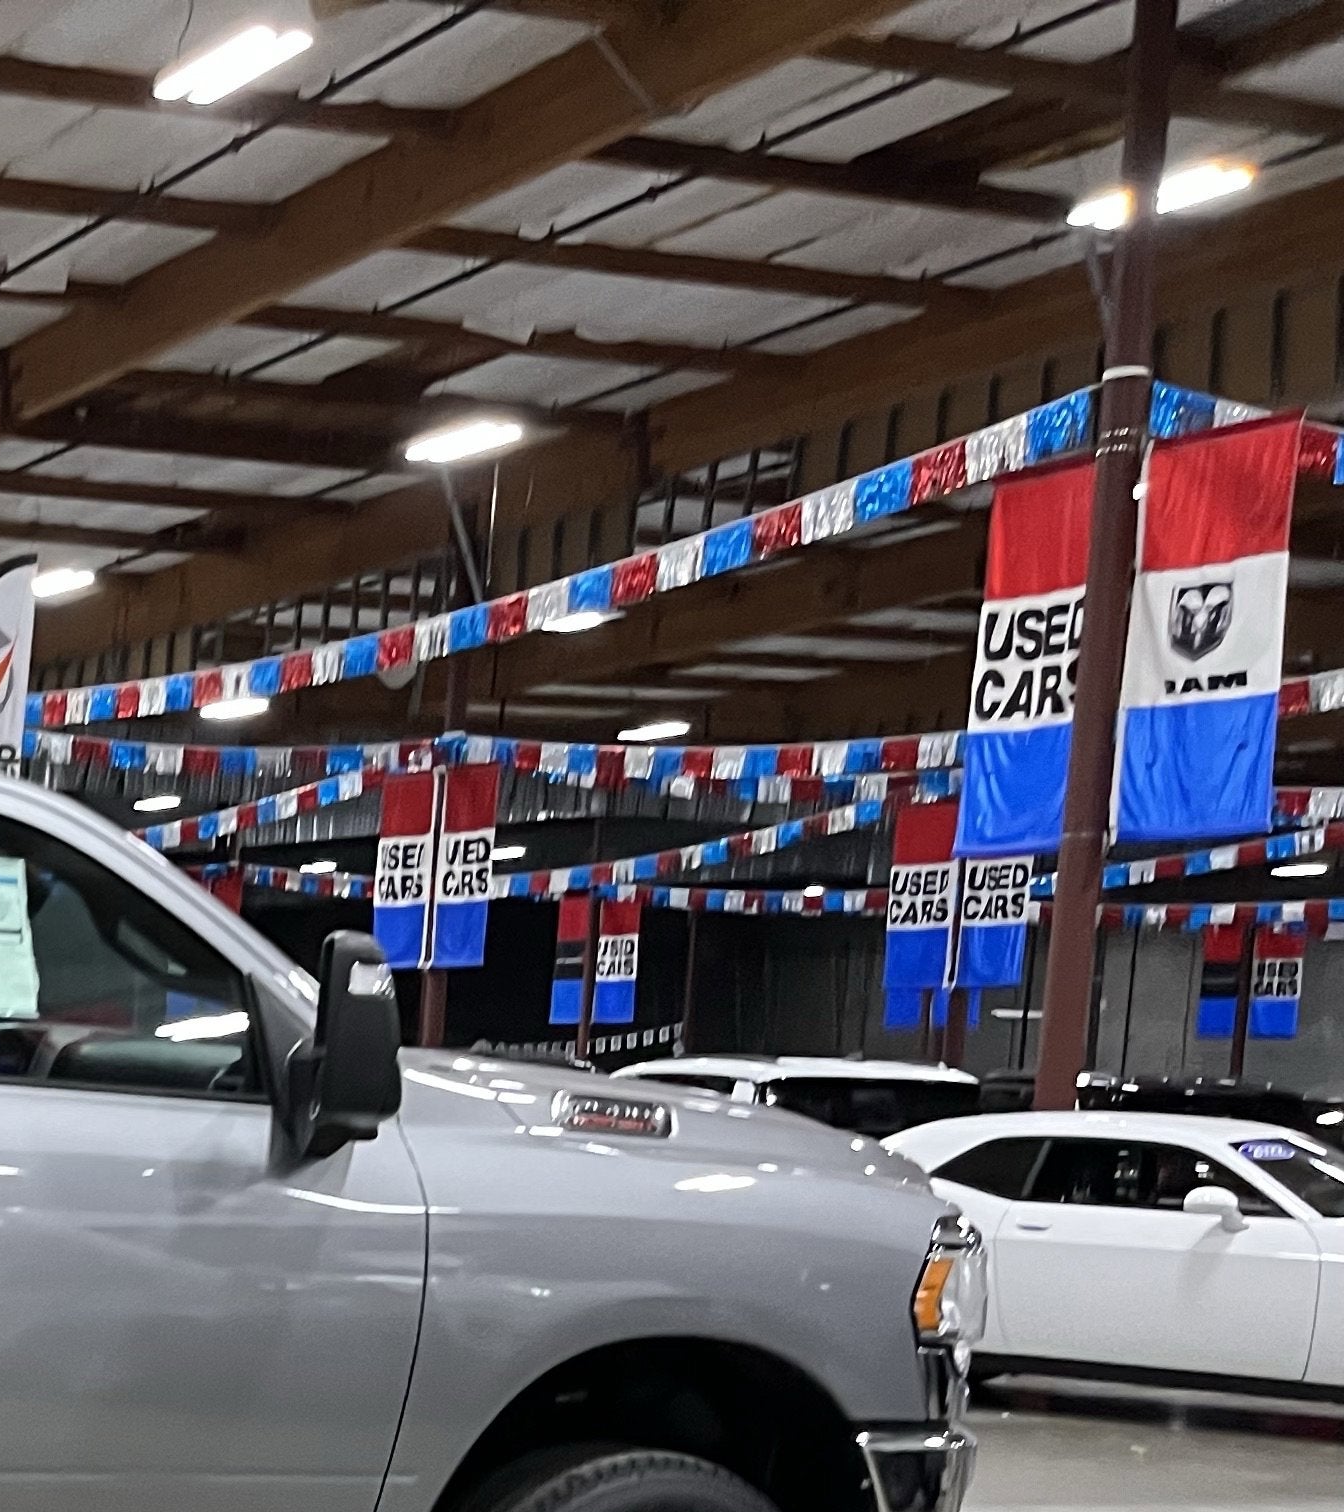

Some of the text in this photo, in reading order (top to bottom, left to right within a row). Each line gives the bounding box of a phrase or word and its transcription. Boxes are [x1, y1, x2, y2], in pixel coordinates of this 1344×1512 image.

[446, 837, 491, 865] UED
[891, 868, 950, 896] USED
[968, 863, 1030, 891] USED
[889, 897, 949, 925] CARS
[963, 893, 1026, 920] CARS
